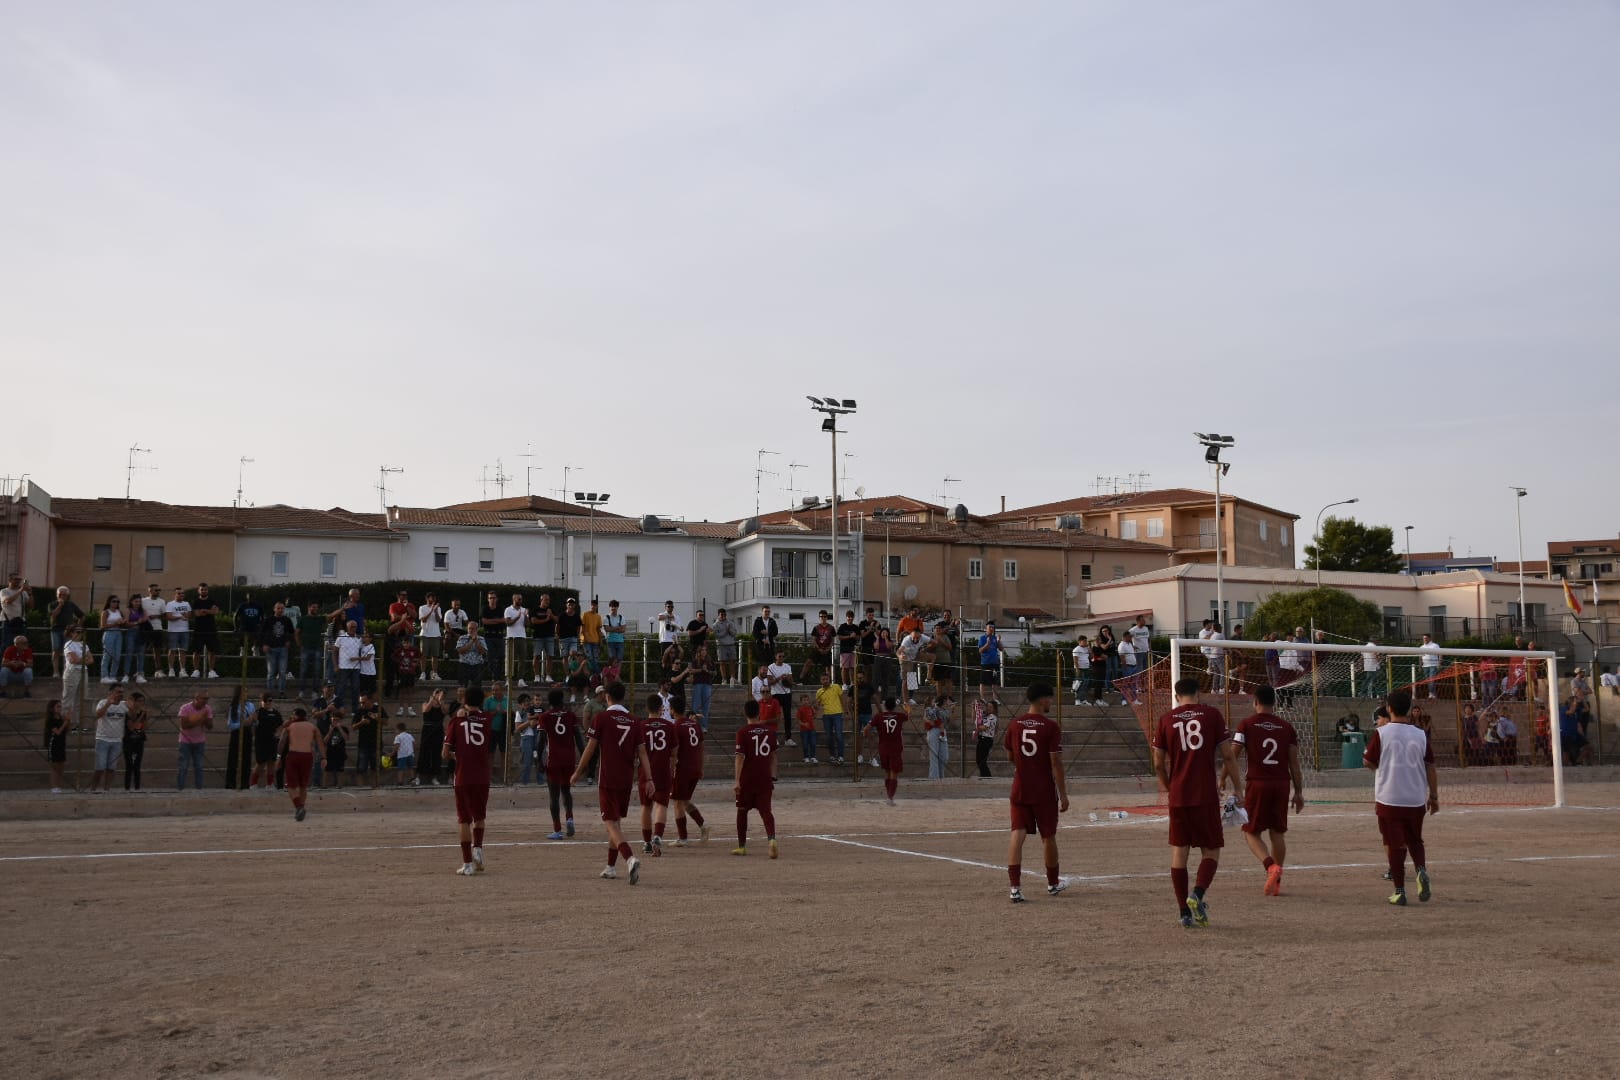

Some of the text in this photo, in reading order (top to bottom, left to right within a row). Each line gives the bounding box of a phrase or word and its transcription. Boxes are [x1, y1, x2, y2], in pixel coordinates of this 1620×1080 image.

[459, 720, 485, 746] 15
[554, 716, 566, 735] 6
[616, 724, 631, 746] 7
[688, 727, 699, 746] 8
[883, 718, 897, 733] 19
[1172, 719, 1204, 752] 18
[645, 729, 667, 751] 13
[751, 734, 771, 756] 16
[1021, 729, 1038, 757] 5
[1262, 737, 1279, 765] 2
